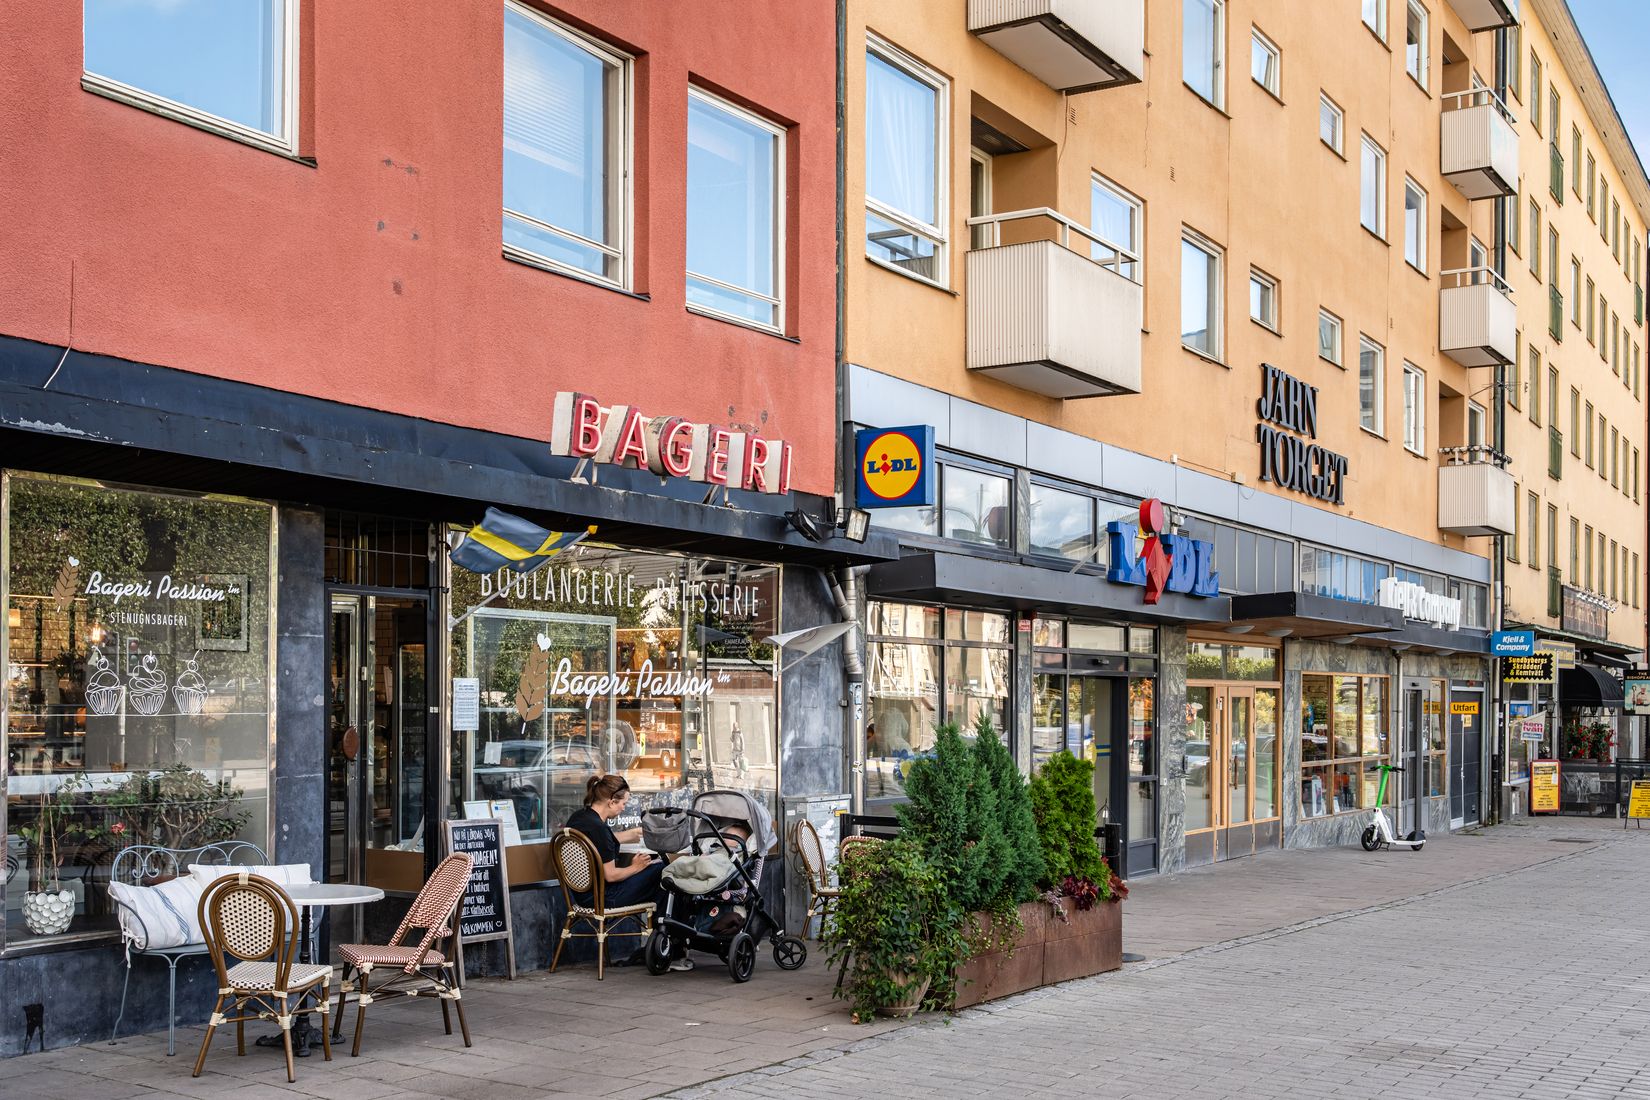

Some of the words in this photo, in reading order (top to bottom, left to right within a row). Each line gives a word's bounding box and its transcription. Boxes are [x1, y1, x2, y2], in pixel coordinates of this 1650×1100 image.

[1259, 363, 1319, 439] JÄRN
[551, 391, 793, 496] BAGERI
[1258, 424, 1349, 506] TORGET
[84, 570, 152, 604] Bageri
[156, 575, 226, 602] Passion
[480, 566, 636, 609] BOULANGERIE
[655, 571, 760, 617] PÂTISSERIE
[110, 611, 188, 627] STENUGNSBAGERI
[1495, 643, 1531, 652] Company
[1502, 635, 1518, 644] Kjell
[1518, 635, 1525, 643] &
[1508, 656, 1548, 665] Sundbybergs
[550, 658, 630, 710] Bageri
[635, 658, 715, 698] Passion
[1453, 703, 1476, 712] Utfart
[461, 920, 494, 934] VÄLKOMMEN
